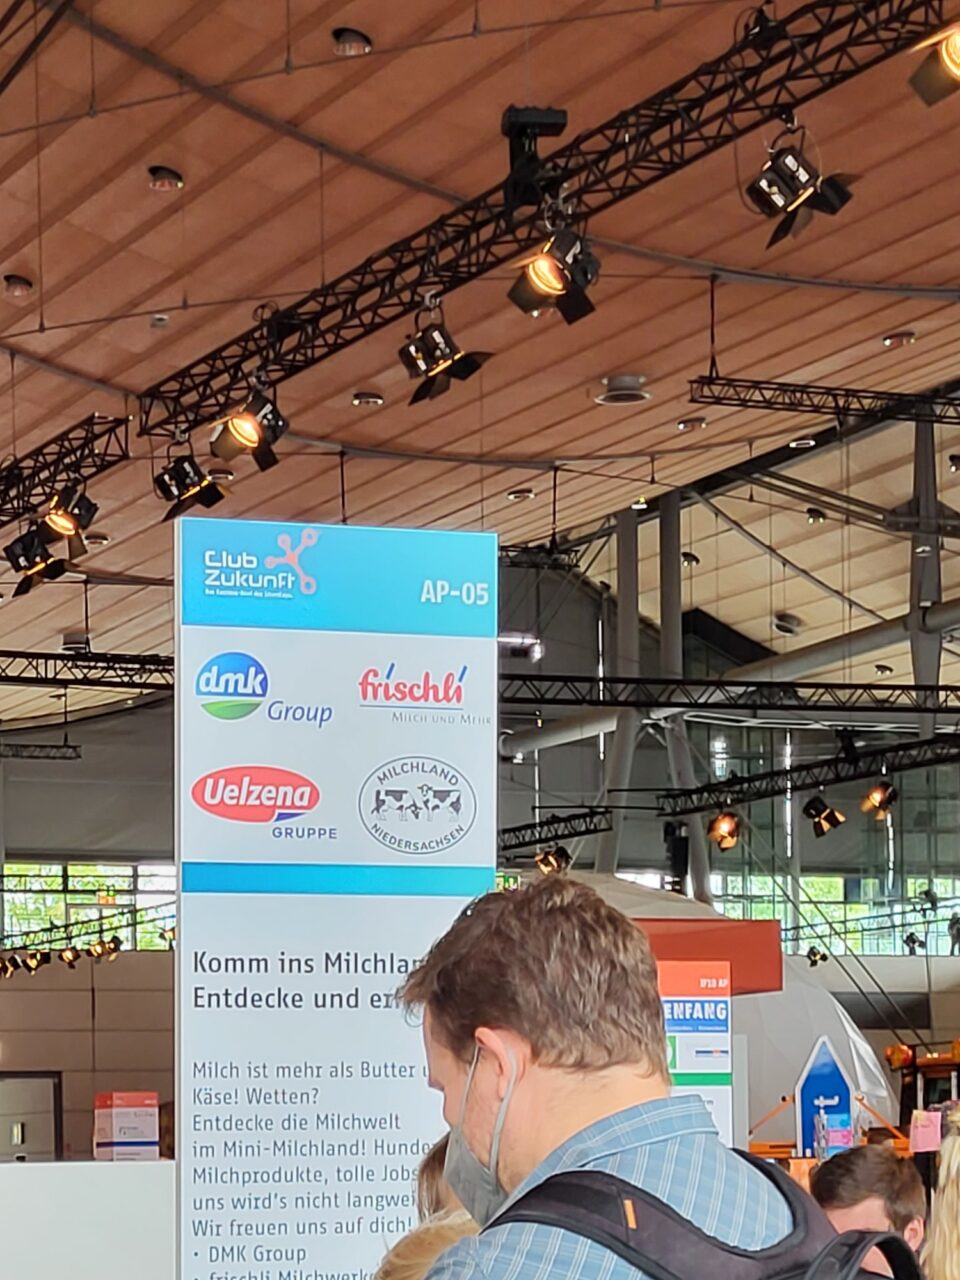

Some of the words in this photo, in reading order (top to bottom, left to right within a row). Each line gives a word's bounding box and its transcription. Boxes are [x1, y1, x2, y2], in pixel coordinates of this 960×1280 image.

[205, 550, 258, 569] Club
[420, 579, 490, 606] AP-05
[199, 665, 265, 696] dmk
[267, 700, 333, 728] Group
[376, 761, 460, 788] MILCHLAND
[204, 775, 311, 807] Uelzena
[271, 826, 338, 840] GRUPPE
[371, 822, 465, 852] NIEDERSACHSEN
[193, 951, 269, 975] Komm
[278, 951, 315, 974] ins
[193, 986, 304, 1009] Entdecke
[313, 987, 360, 1009] und
[193, 1062, 240, 1080] Milch
[246, 1062, 269, 1079] ist
[276, 1061, 323, 1079] mehr
[329, 1061, 354, 1078] als
[361, 1060, 416, 1078] Butter
[193, 1086, 240, 1106] Käse!
[245, 1087, 320, 1106] Wetten?
[193, 1114, 274, 1132] Entdecke
[281, 1113, 309, 1131] die
[316, 1112, 401, 1130] Milchwelt
[193, 1141, 215, 1158] im
[223, 1139, 366, 1158] Mini-Milchland!
[374, 1138, 434, 1156] Hunde
[193, 1166, 329, 1188] Milchprodukte,
[337, 1164, 375, 1183] tolle
[193, 1195, 225, 1211] uns
[231, 1192, 287, 1210] wird's
[294, 1192, 340, 1209] nicht
[193, 1219, 223, 1237] Wir
[229, 1218, 289, 1237] freuen
[295, 1221, 327, 1236] uns
[334, 1216, 364, 1234] auf
[369, 1216, 413, 1233] dich!
[209, 1245, 247, 1263] DMK
[253, 1244, 307, 1266] Group
